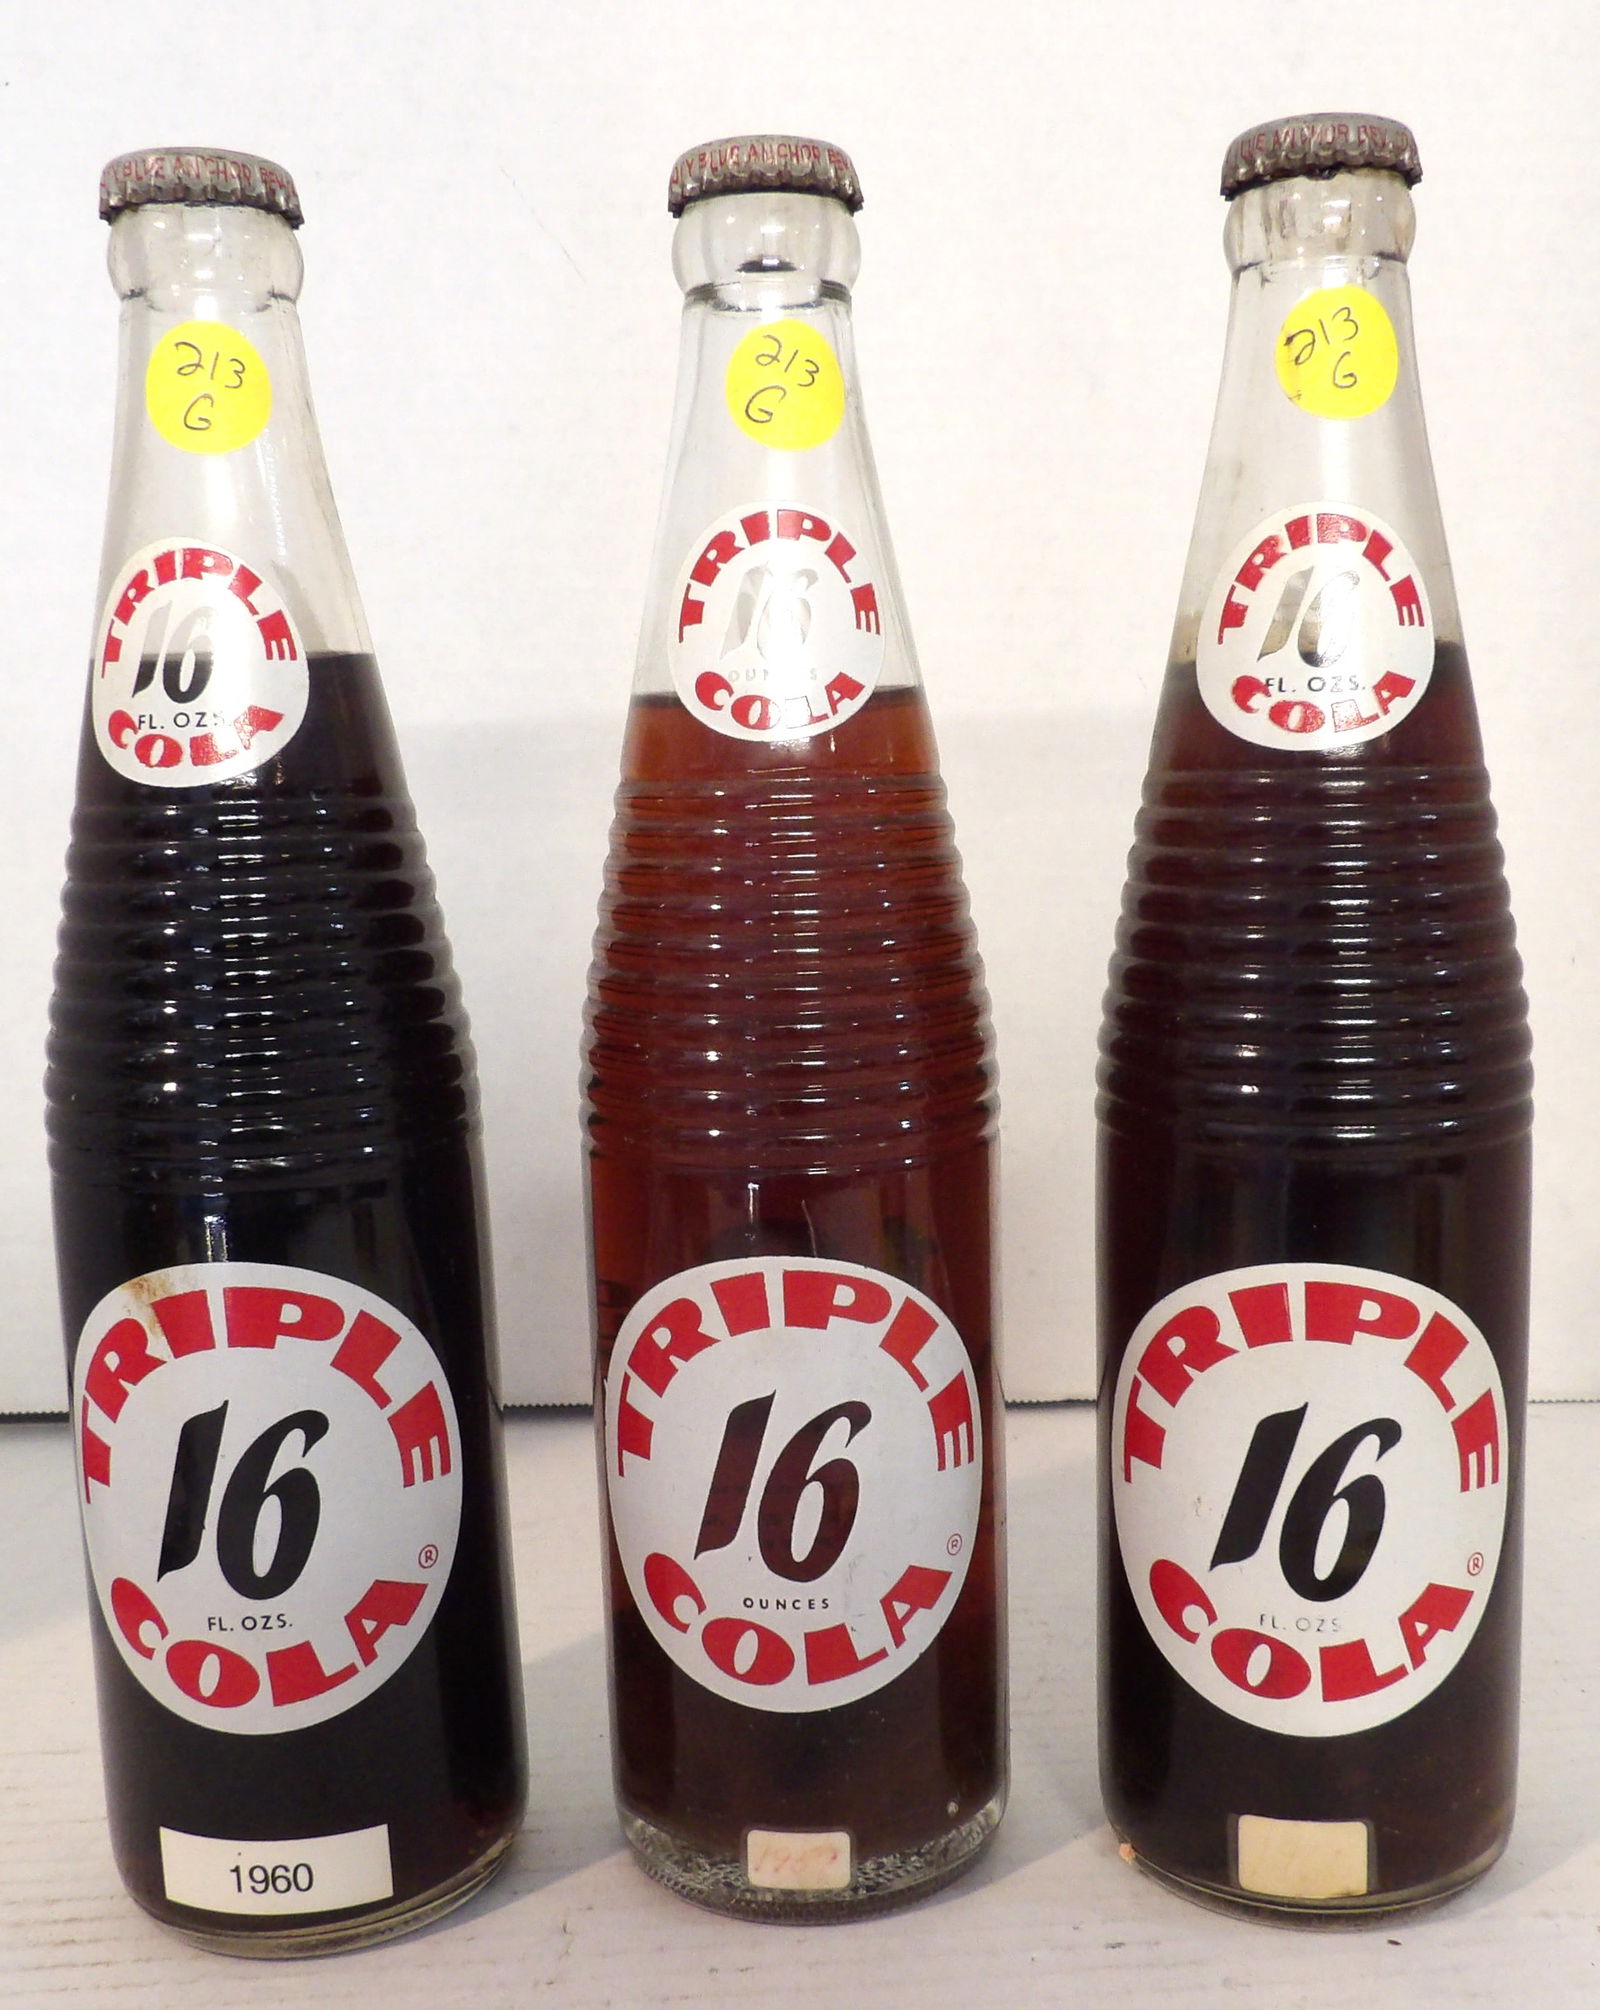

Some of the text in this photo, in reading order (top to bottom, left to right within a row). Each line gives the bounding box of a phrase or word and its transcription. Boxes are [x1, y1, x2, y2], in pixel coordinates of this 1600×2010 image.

[174, 341, 246, 389] 213
[754, 334, 820, 388] 213
[1283, 306, 1359, 366] 213
[183, 392, 215, 431] G
[744, 384, 787, 424] G
[101, 547, 298, 680] TRIPLE
[678, 508, 881, 644] TRIPLE
[1217, 512, 1425, 646] TRIPLE
[107, 704, 285, 769] COLA
[137, 713, 165, 730] FL.
[694, 671, 866, 731] COLA
[1231, 670, 1417, 734] COLA
[81, 1286, 453, 1505] TRIPLE
[618, 1269, 975, 1478] TRIPLE
[1123, 1280, 1500, 1493] TRIPLE
[156, 1399, 331, 1601] 16
[693, 1388, 873, 1584] 16
[1208, 1401, 1403, 1603] 16
[110, 1576, 430, 1709] COLA
[207, 1613, 293, 1632] FL. OZS.
[643, 1551, 953, 1687] COLA
[742, 1596, 831, 1611] OUNCES
[1148, 1558, 1475, 1703] COLA
[229, 1862, 315, 1894] 1960
